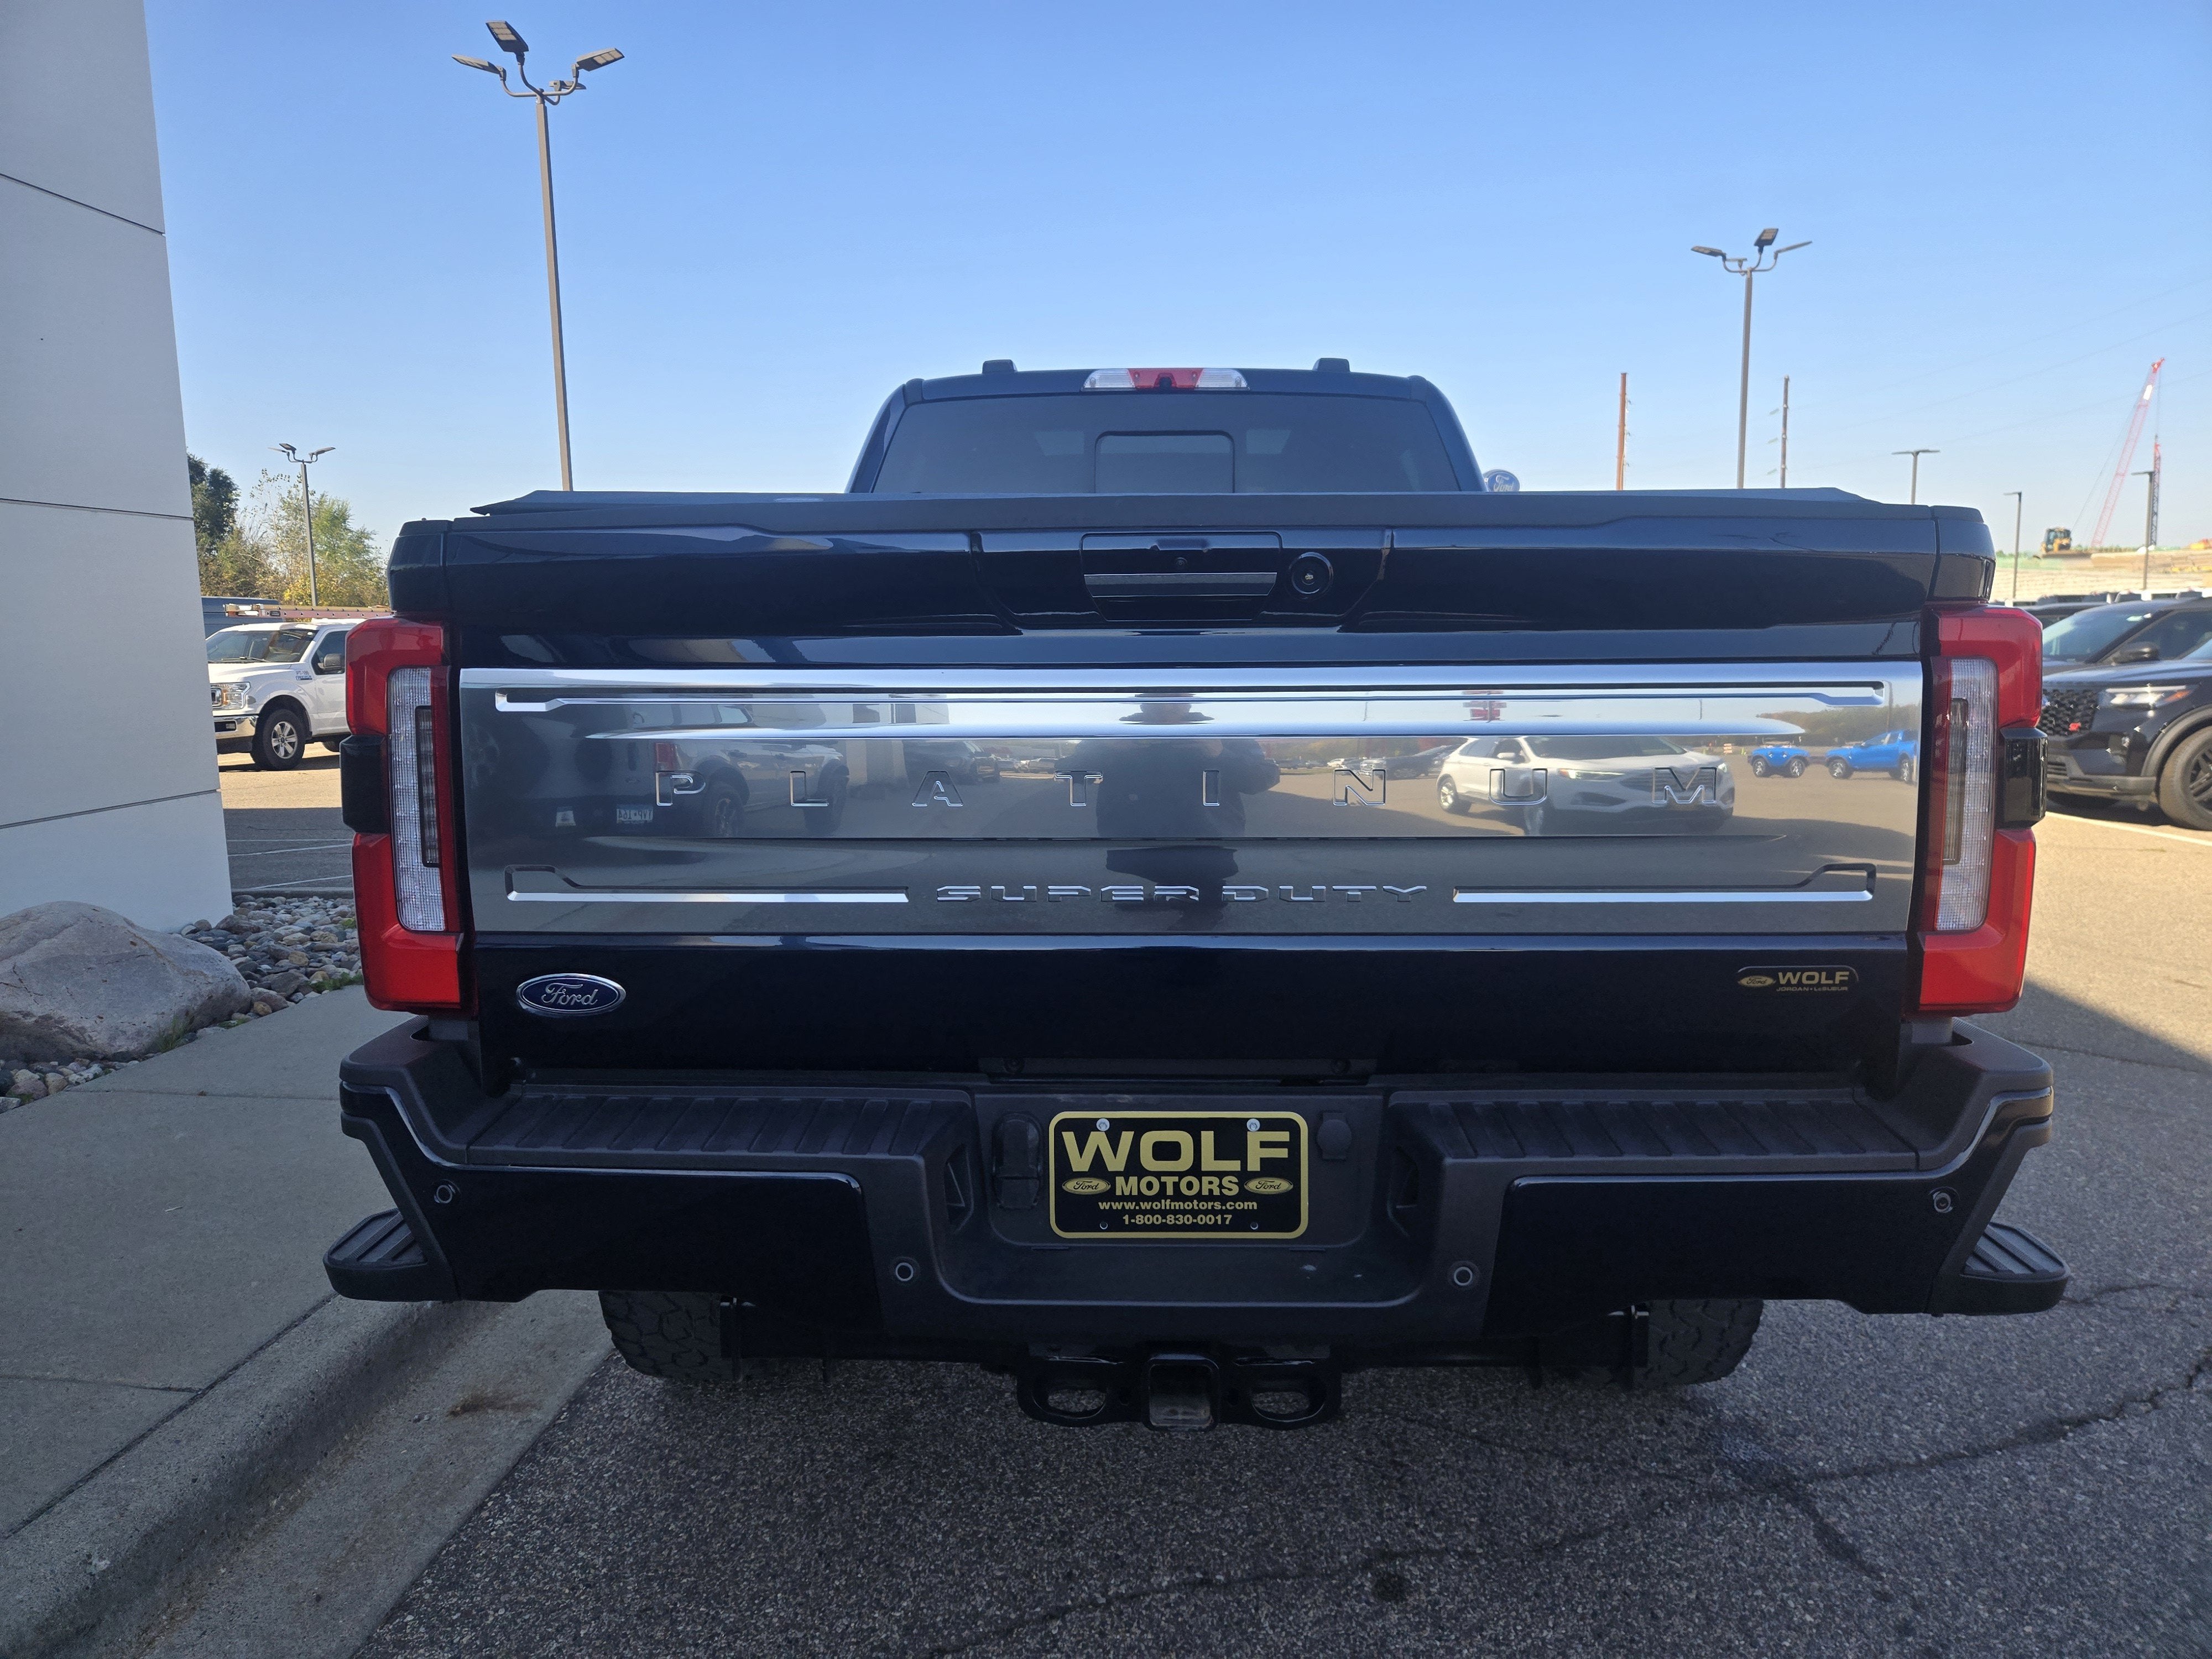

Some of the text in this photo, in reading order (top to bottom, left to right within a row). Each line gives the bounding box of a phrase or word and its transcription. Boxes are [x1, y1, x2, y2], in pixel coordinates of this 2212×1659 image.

[655, 768, 1717, 807] PLATINUM
[936, 885, 1428, 902] SUPER DUTY
[1746, 977, 1767, 985] Ford
[1778, 971, 1850, 985] WOLF
[540, 982, 599, 1006] Ford
[1061, 1130, 1290, 1172] WOLF
[1073, 1180, 1100, 1191] Ford
[1115, 1176, 1239, 1196] MOTORS
[1255, 1180, 1282, 1190] Ford
[1098, 1199, 1258, 1210] www.wolfmotors.com
[1122, 1214, 1233, 1225] 1-800-830-0017
